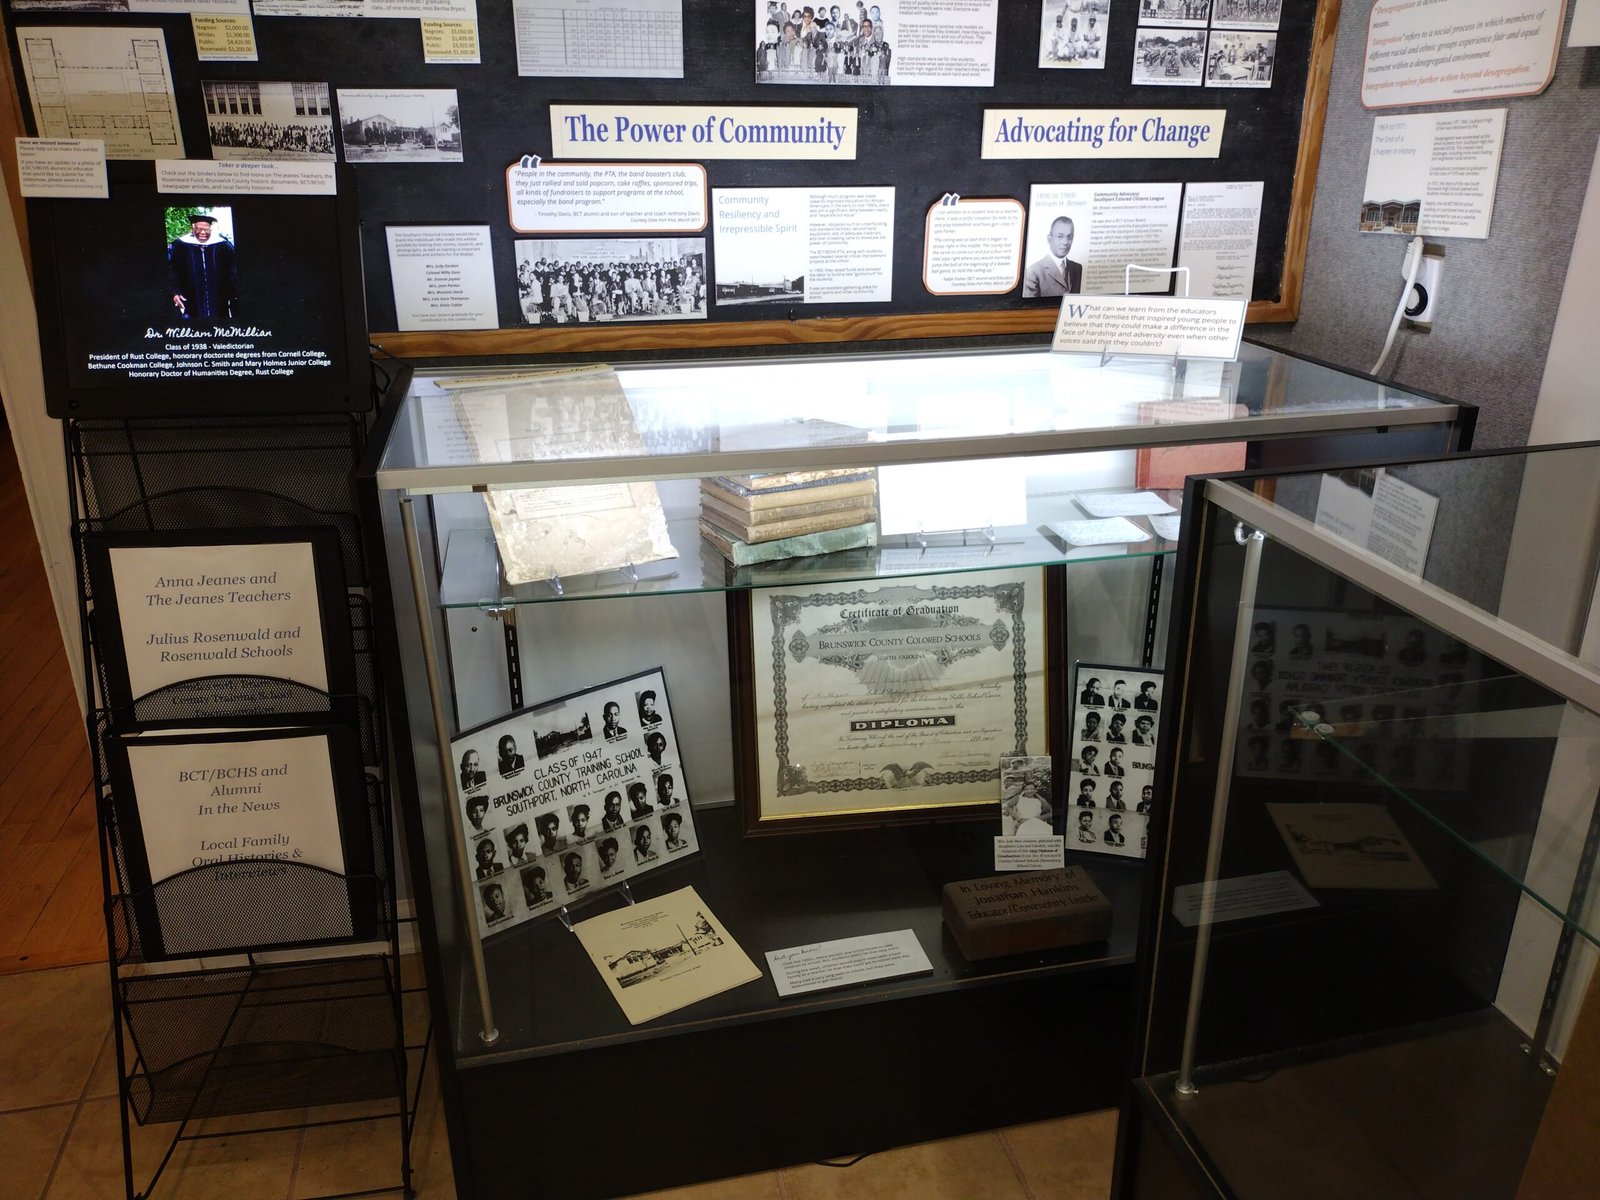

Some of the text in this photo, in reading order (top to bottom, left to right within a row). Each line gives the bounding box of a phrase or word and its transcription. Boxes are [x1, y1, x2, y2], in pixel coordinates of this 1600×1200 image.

[564, 114, 846, 150] The Power of Community
[994, 116, 1210, 148] Advocating for Change
[556, 170, 591, 178] community,
[515, 179, 529, 188] they
[528, 180, 541, 188] just
[588, 180, 615, 188] popcorn,
[631, 180, 651, 188] raffles,
[683, 180, 698, 188] trips,
[516, 198, 546, 206] especially
[718, 195, 769, 206] Community
[718, 209, 779, 221] Resiliency and
[719, 224, 797, 235] Irrepressible Spirit
[1146, 315, 1176, 323] inspired
[1200, 317, 1227, 325] people
[143, 326, 272, 338] Dr. William McMillian
[1113, 339, 1129, 347] they
[120, 352, 128, 360] of
[145, 352, 171, 360] College,
[235, 351, 261, 359] degrees
[301, 350, 327, 358] College,
[154, 571, 276, 588] Anna Jeanes and
[145, 590, 291, 606] The Jeanes Teachers
[839, 604, 958, 619] Certificate of Graduation
[146, 626, 300, 645] Julius Rosenwald and
[818, 633, 981, 650] BRUNSWICK COUNTY COLORED SCHOOLS
[159, 645, 292, 662] Rosenwald Schools
[855, 717, 949, 729] DIPLOMA
[534, 748, 602, 780] CLASS OF 1947
[178, 763, 287, 782] BCT/BCHS and
[493, 784, 535, 808] BRUNSWICK
[537, 773, 570, 792] COUNTY
[576, 758, 612, 779] TRAINING
[614, 748, 645, 765] SCHOOL
[560, 779, 590, 797] NORTH
[596, 763, 637, 784] CAROLINA
[210, 782, 261, 796] Alumni
[197, 801, 280, 815] In the News
[199, 833, 289, 850] Local Family
[192, 855, 223, 867] Oral
[292, 848, 303, 858] &
[959, 870, 1076, 894] In Loving Memory of
[974, 884, 1079, 905] Jonathan Hankins
